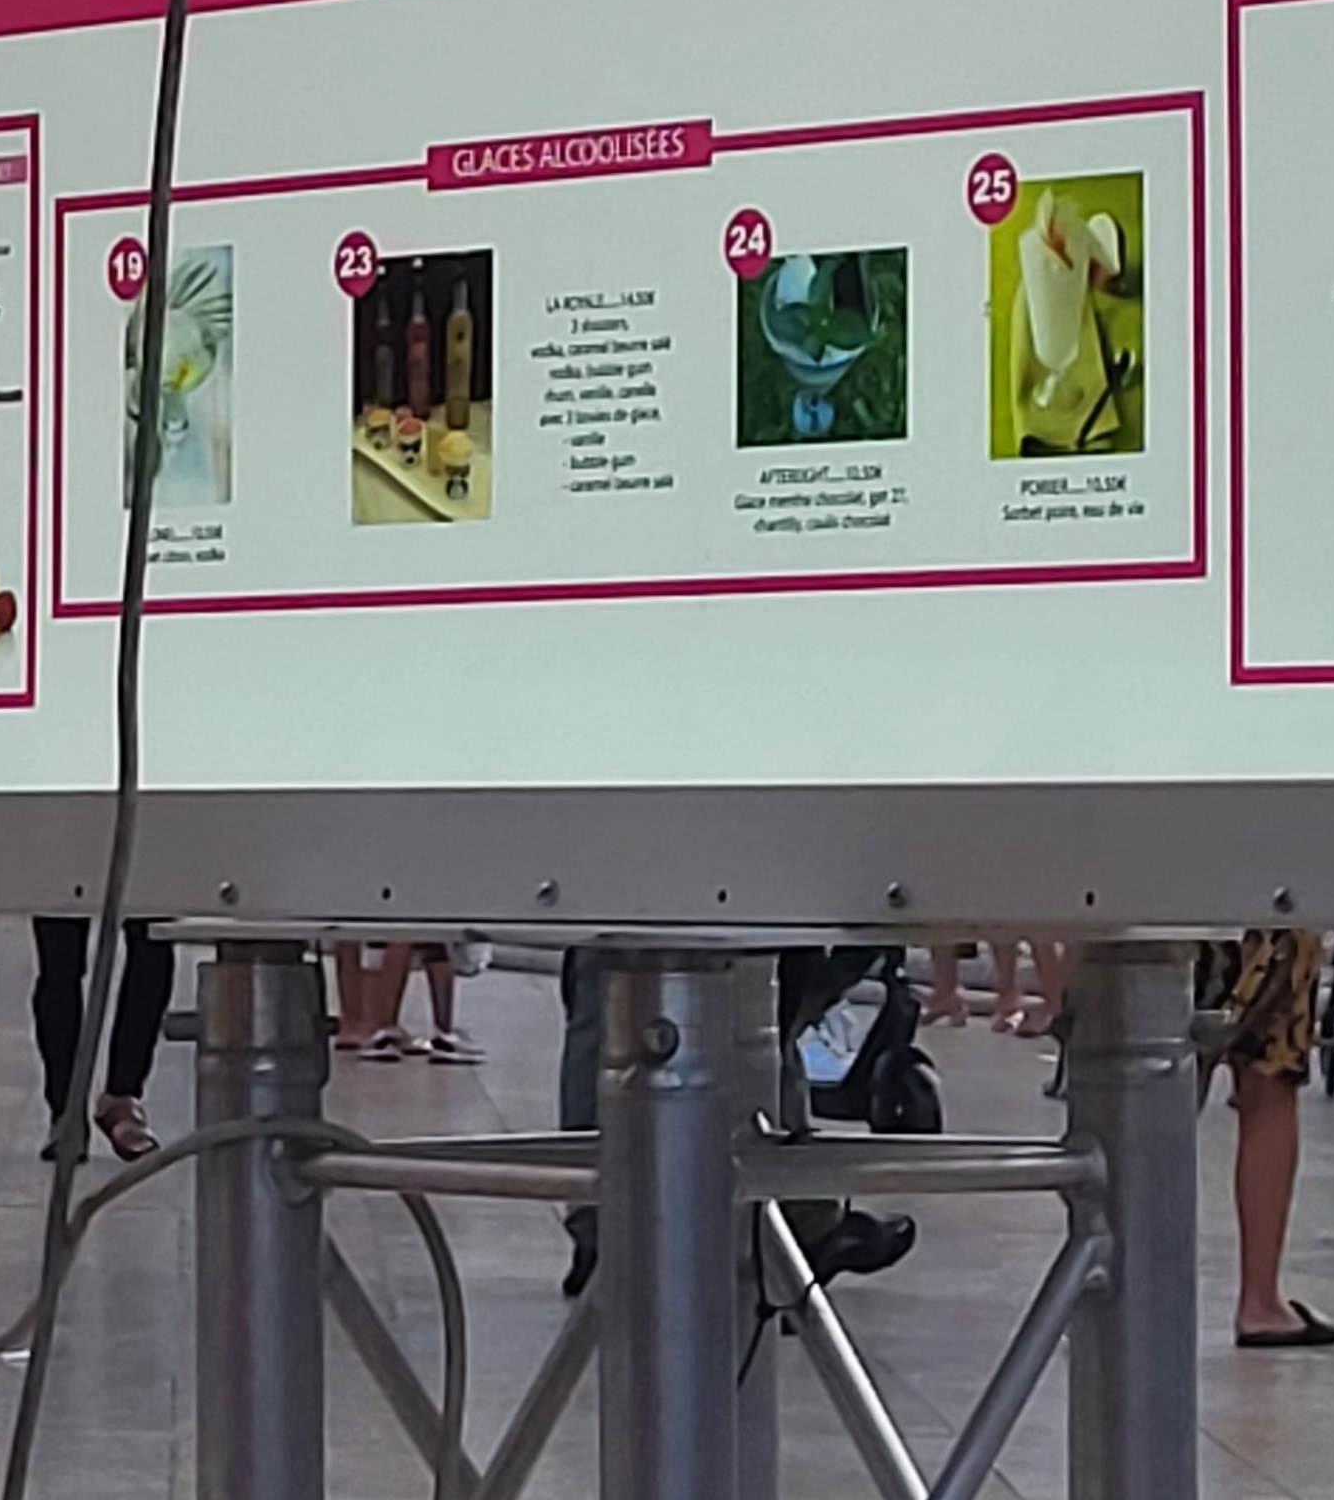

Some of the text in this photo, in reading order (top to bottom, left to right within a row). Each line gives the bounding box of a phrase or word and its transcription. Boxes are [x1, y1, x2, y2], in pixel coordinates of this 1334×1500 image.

[452, 127, 685, 178] GLACES ALCOOLISÉES
[973, 170, 1011, 202] 25
[730, 225, 765, 255] 24
[113, 251, 143, 281] 19
[340, 247, 371, 277] 23
